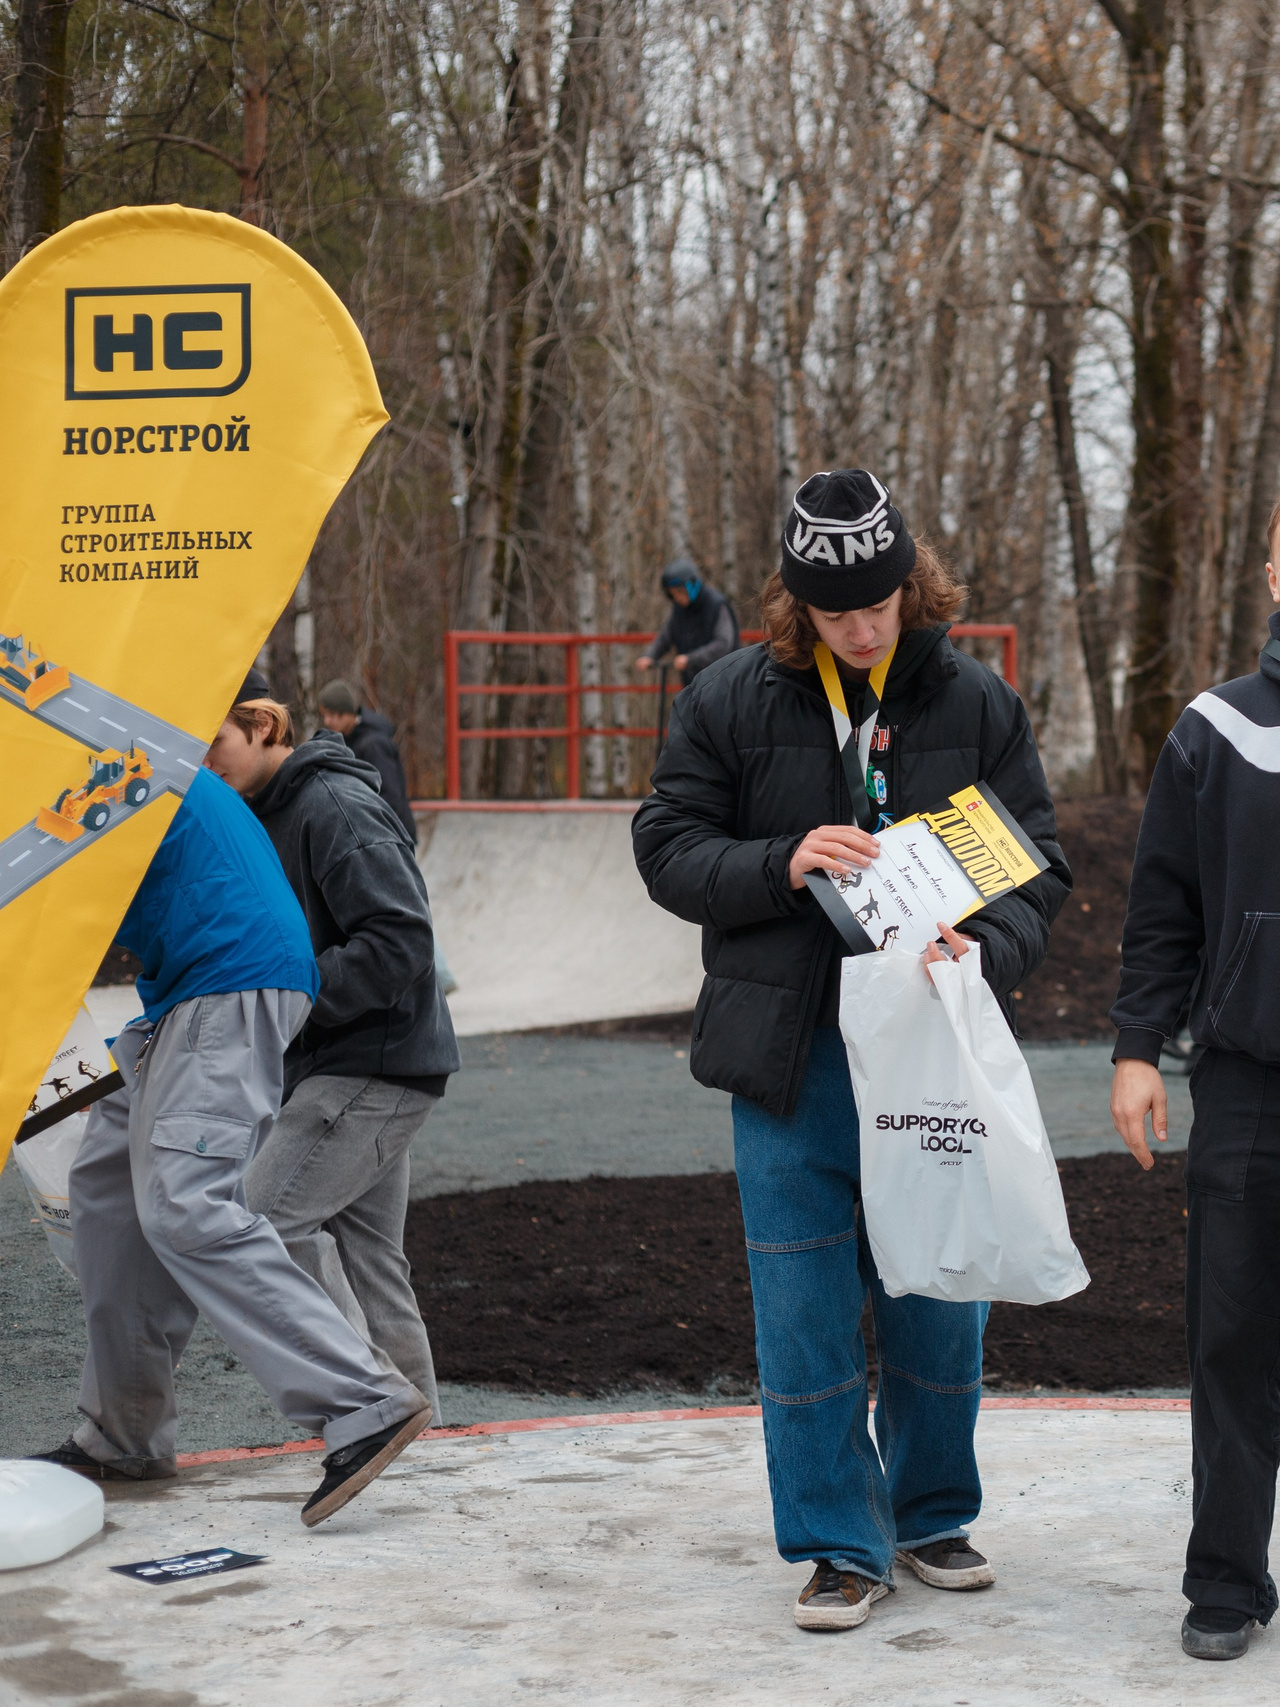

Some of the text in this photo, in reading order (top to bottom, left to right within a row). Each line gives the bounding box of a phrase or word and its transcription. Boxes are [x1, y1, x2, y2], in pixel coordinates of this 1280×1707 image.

[93, 311, 223, 372] НС
[61, 503, 156, 525] ГРУППА
[60, 530, 252, 554] СТРОИТЕЛЬНЫХ
[792, 520, 895, 565] VANS
[59, 556, 200, 583] КОМПАНИЙ
[919, 807, 1016, 898] ДИПЛОМ
[894, 895, 913, 918] STREET
[55, 1045, 78, 1062] STREET
